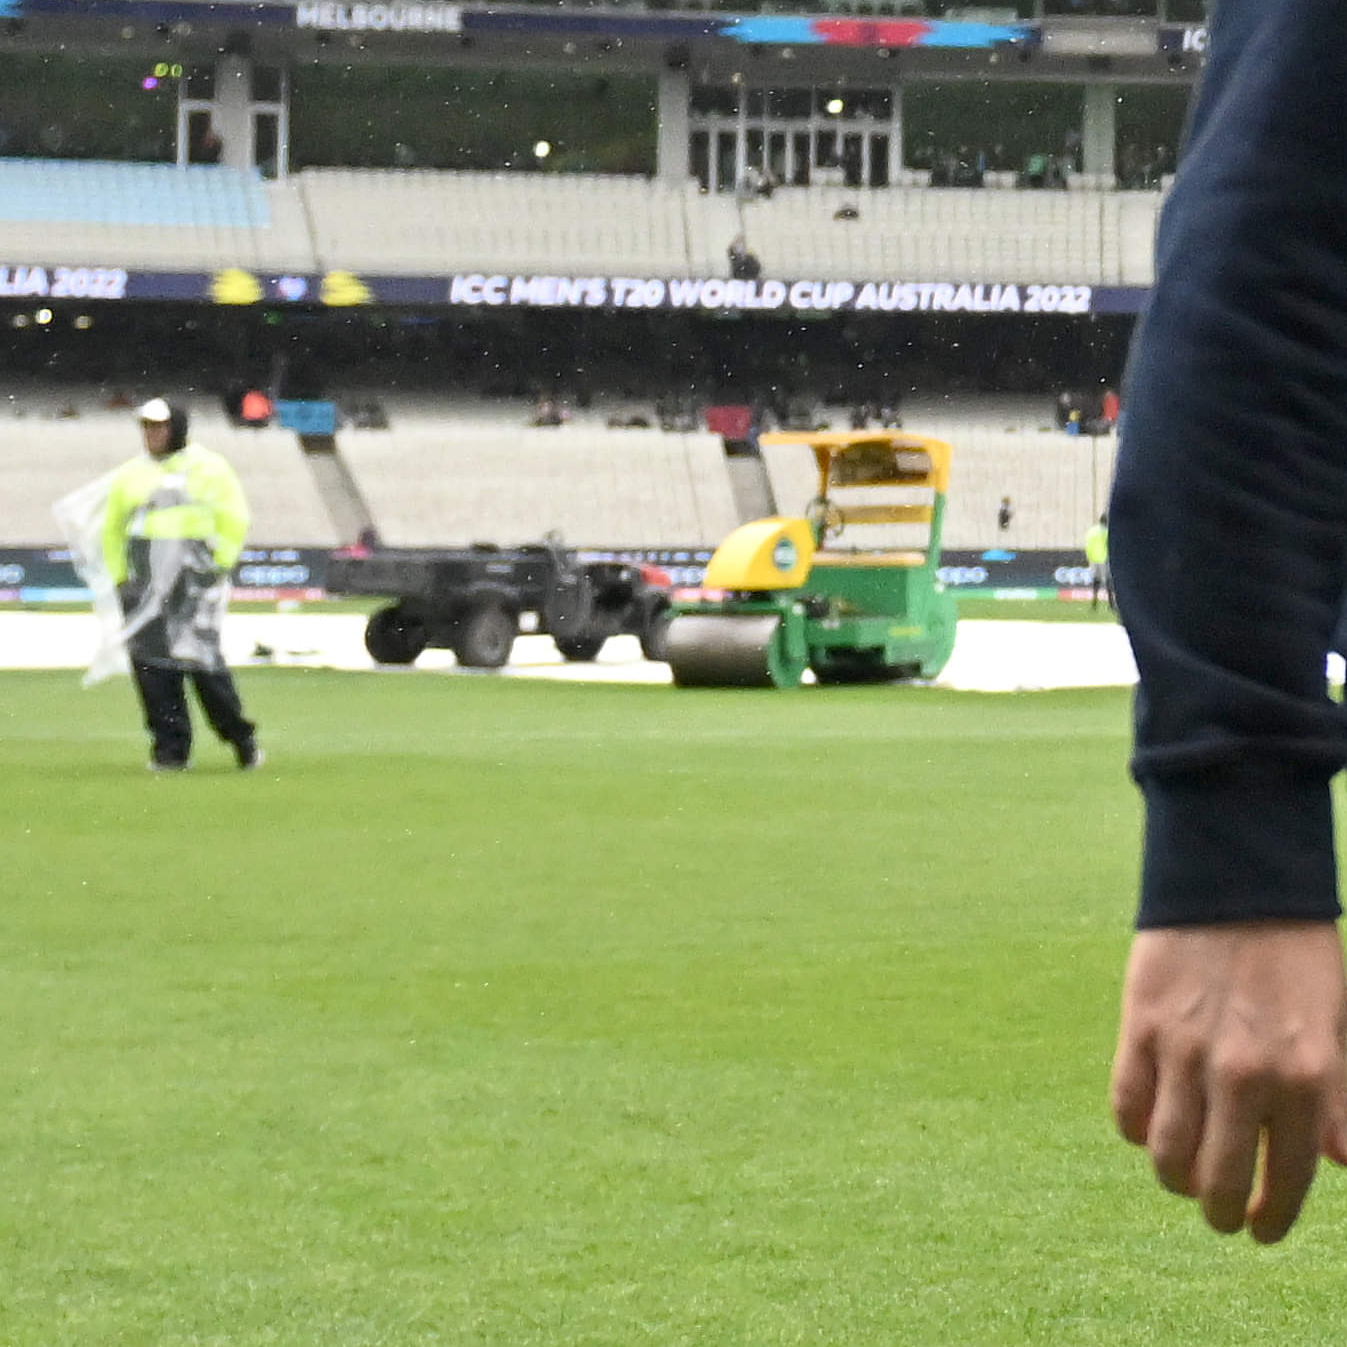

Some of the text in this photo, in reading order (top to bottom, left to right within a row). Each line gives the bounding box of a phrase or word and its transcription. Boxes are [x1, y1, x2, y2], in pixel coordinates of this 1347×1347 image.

[296, 3, 462, 33] MELBOURNE
[51, 267, 127, 299] 2022
[450, 275, 1091, 313] ICC MEN'S T20 WORLD CUP AUSTRALIA 2022
